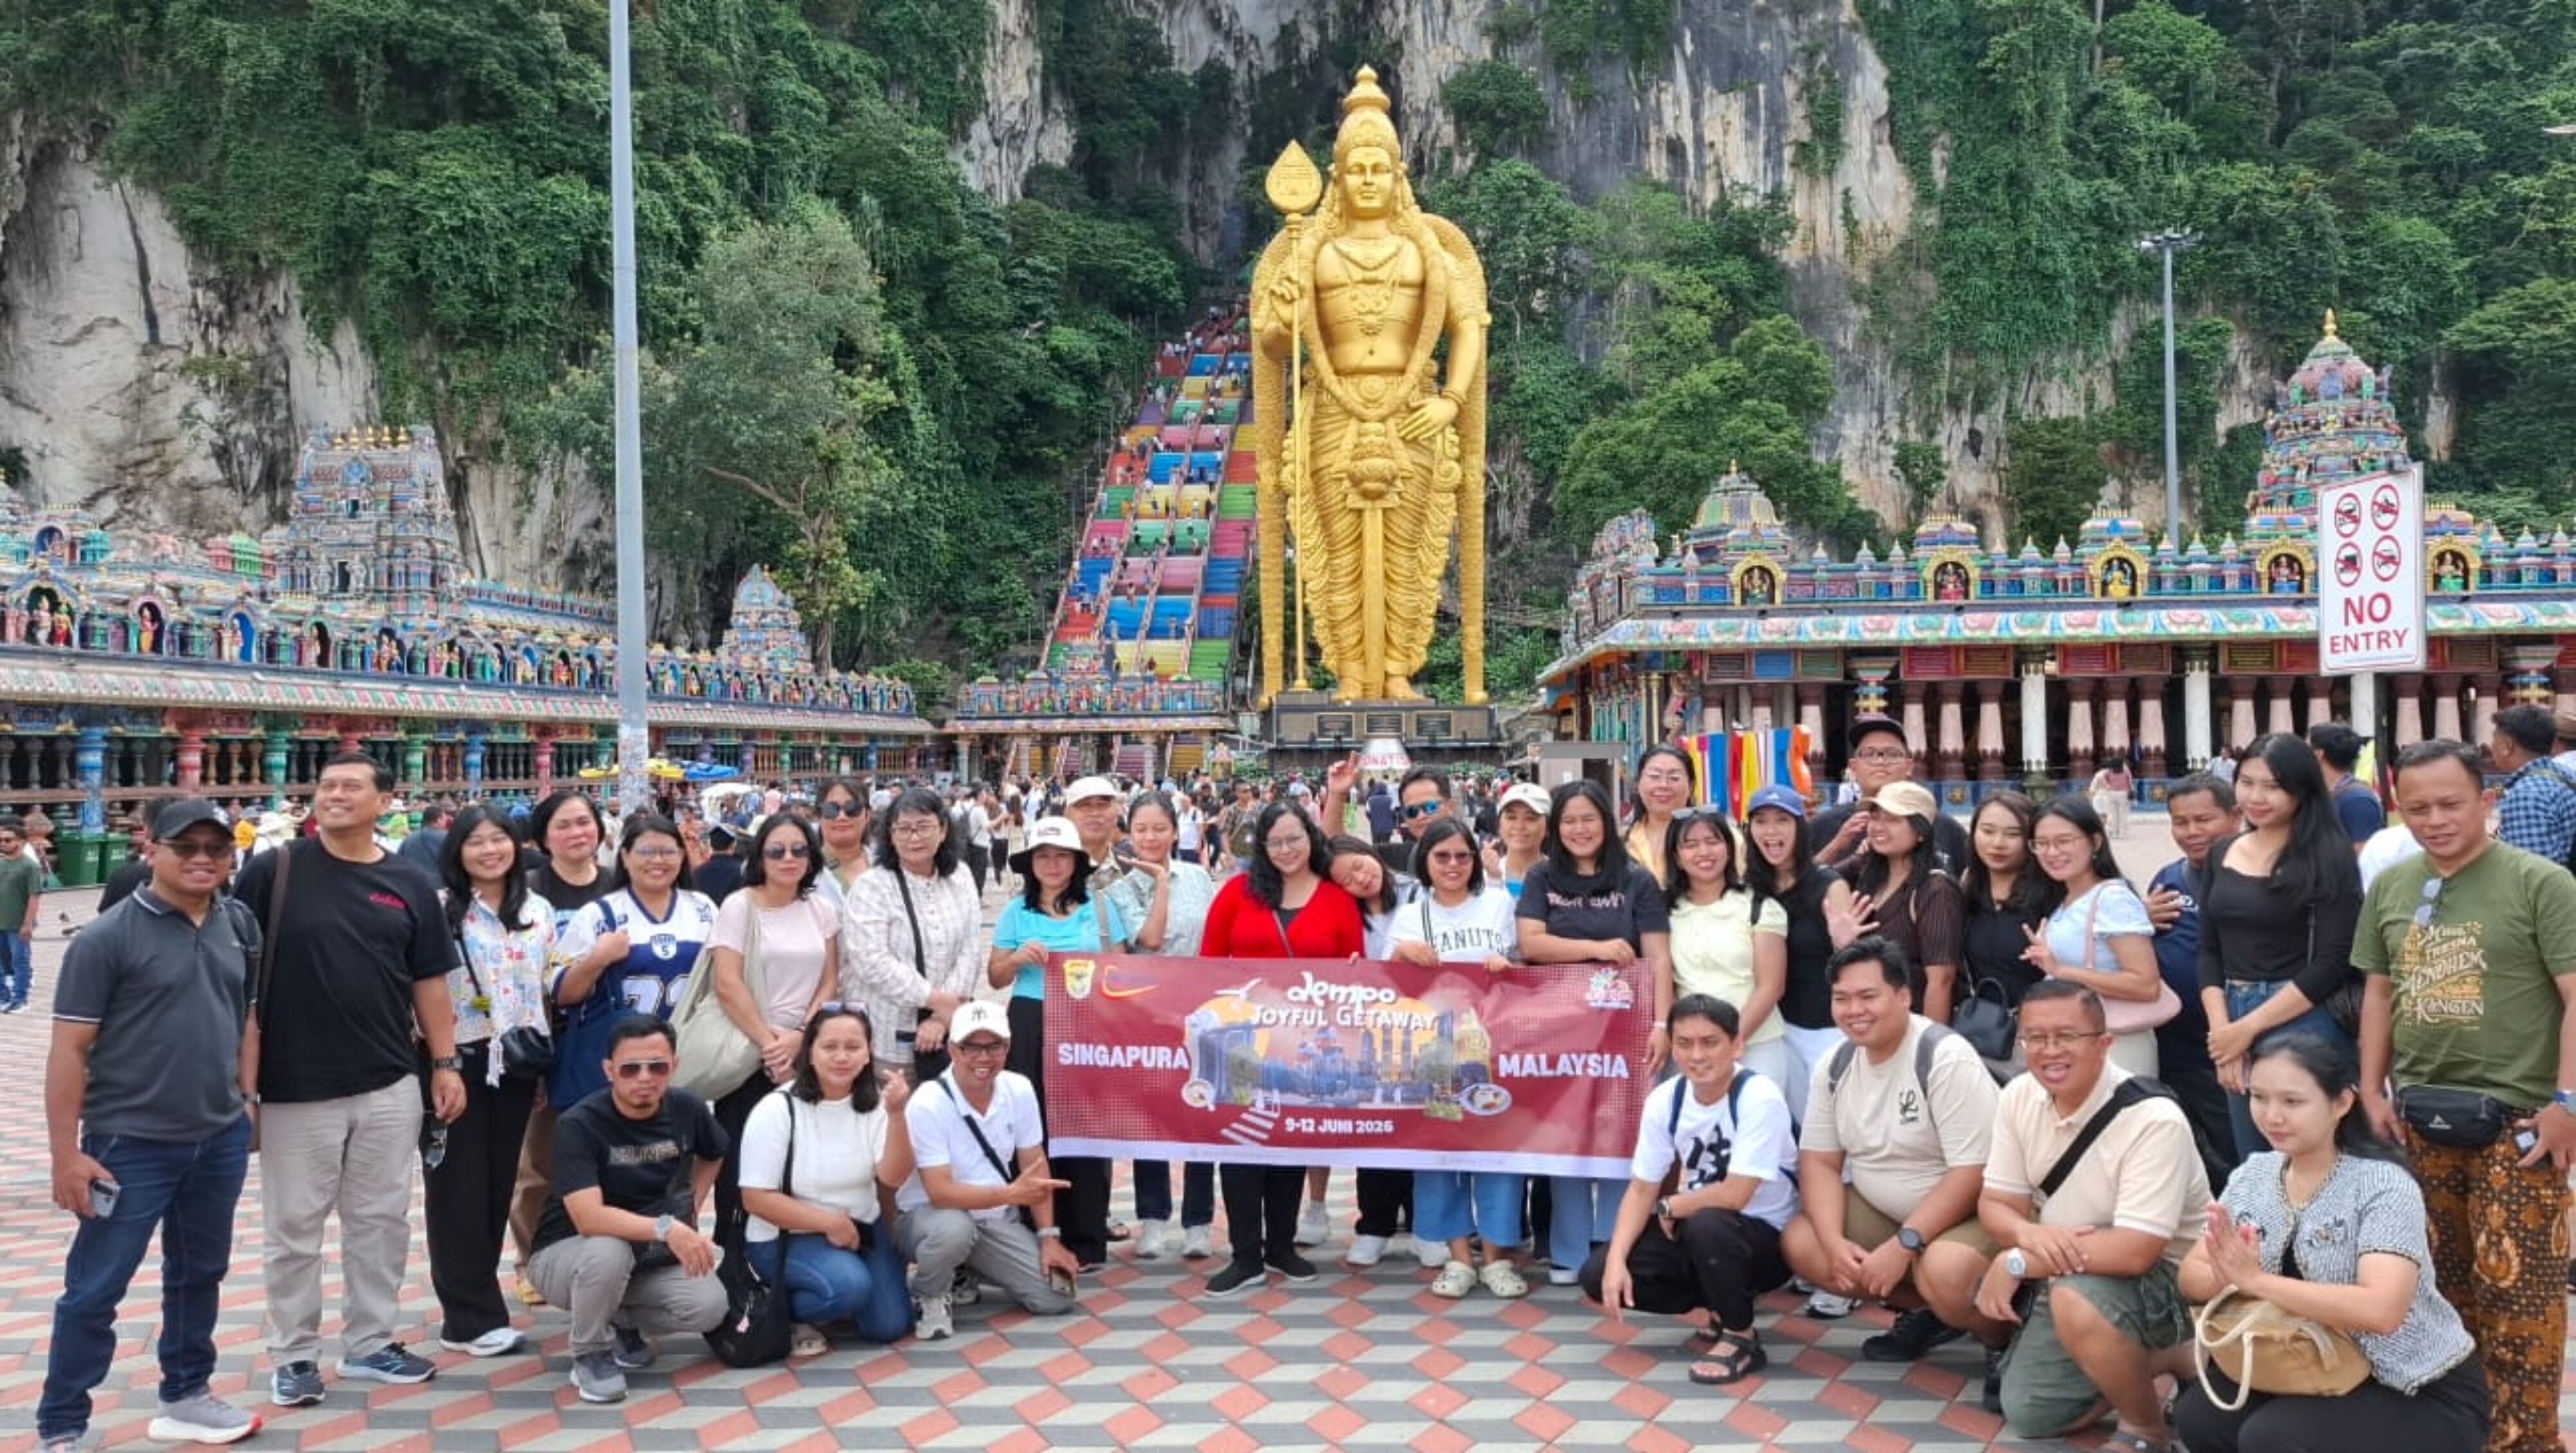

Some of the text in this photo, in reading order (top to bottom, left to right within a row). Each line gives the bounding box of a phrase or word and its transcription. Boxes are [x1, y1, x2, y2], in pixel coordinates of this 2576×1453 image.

[2343, 593, 2392, 627] NO
[2329, 627, 2410, 654] ENTRY
[1251, 1005, 1436, 1030] JOYFUL GETAWAY
[1058, 1042, 1190, 1070] SINGAPURA
[1498, 1052, 1629, 1079] MALAYSIA
[1285, 1117, 1315, 1134] 9-12
[1318, 1118, 1353, 1134] JUNI
